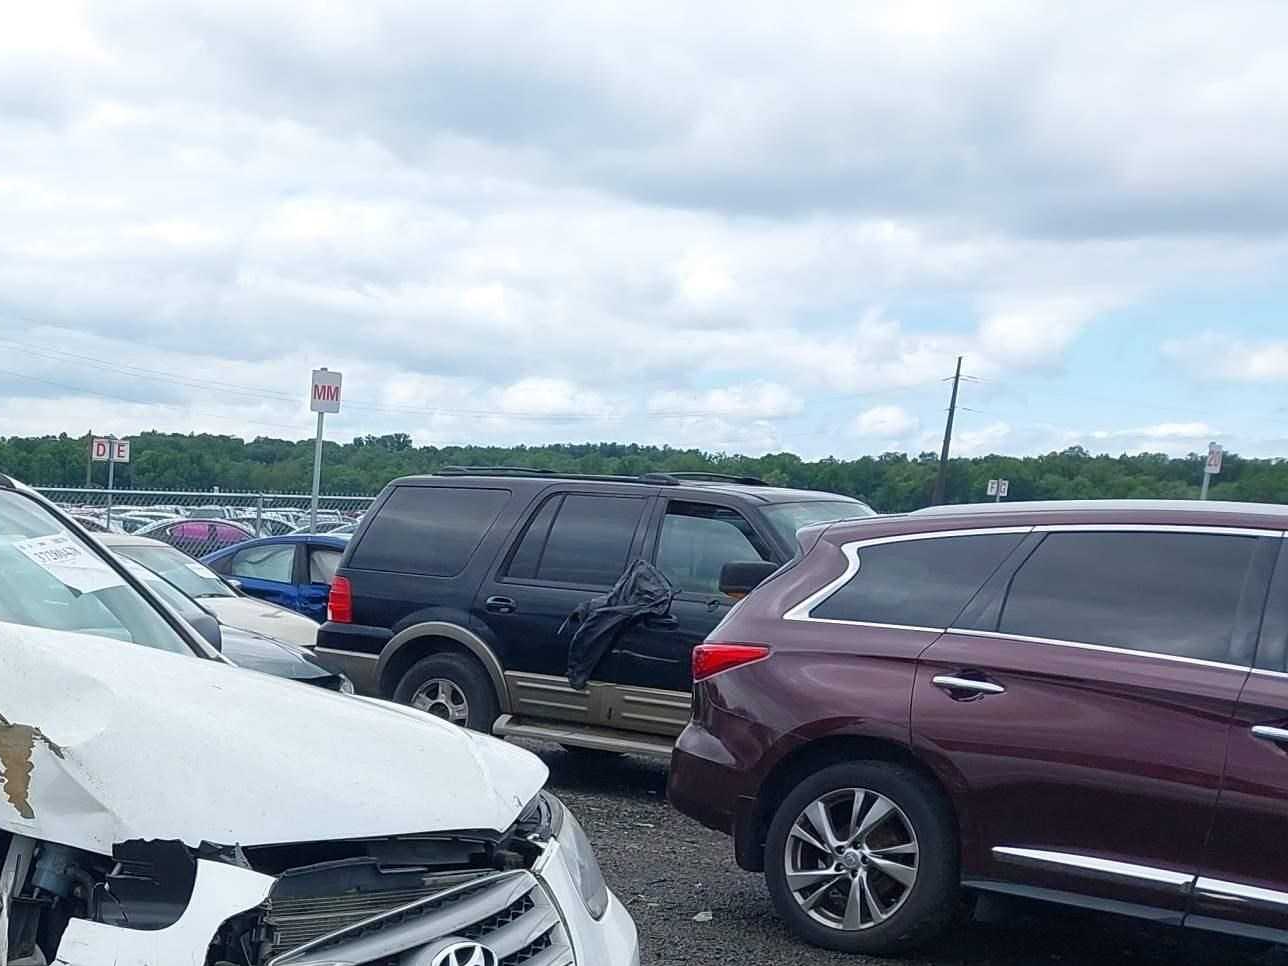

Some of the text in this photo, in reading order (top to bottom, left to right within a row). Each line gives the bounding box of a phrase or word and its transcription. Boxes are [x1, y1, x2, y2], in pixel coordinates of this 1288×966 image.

[313, 384, 339, 401] MM
[96, 443, 126, 458] D E
